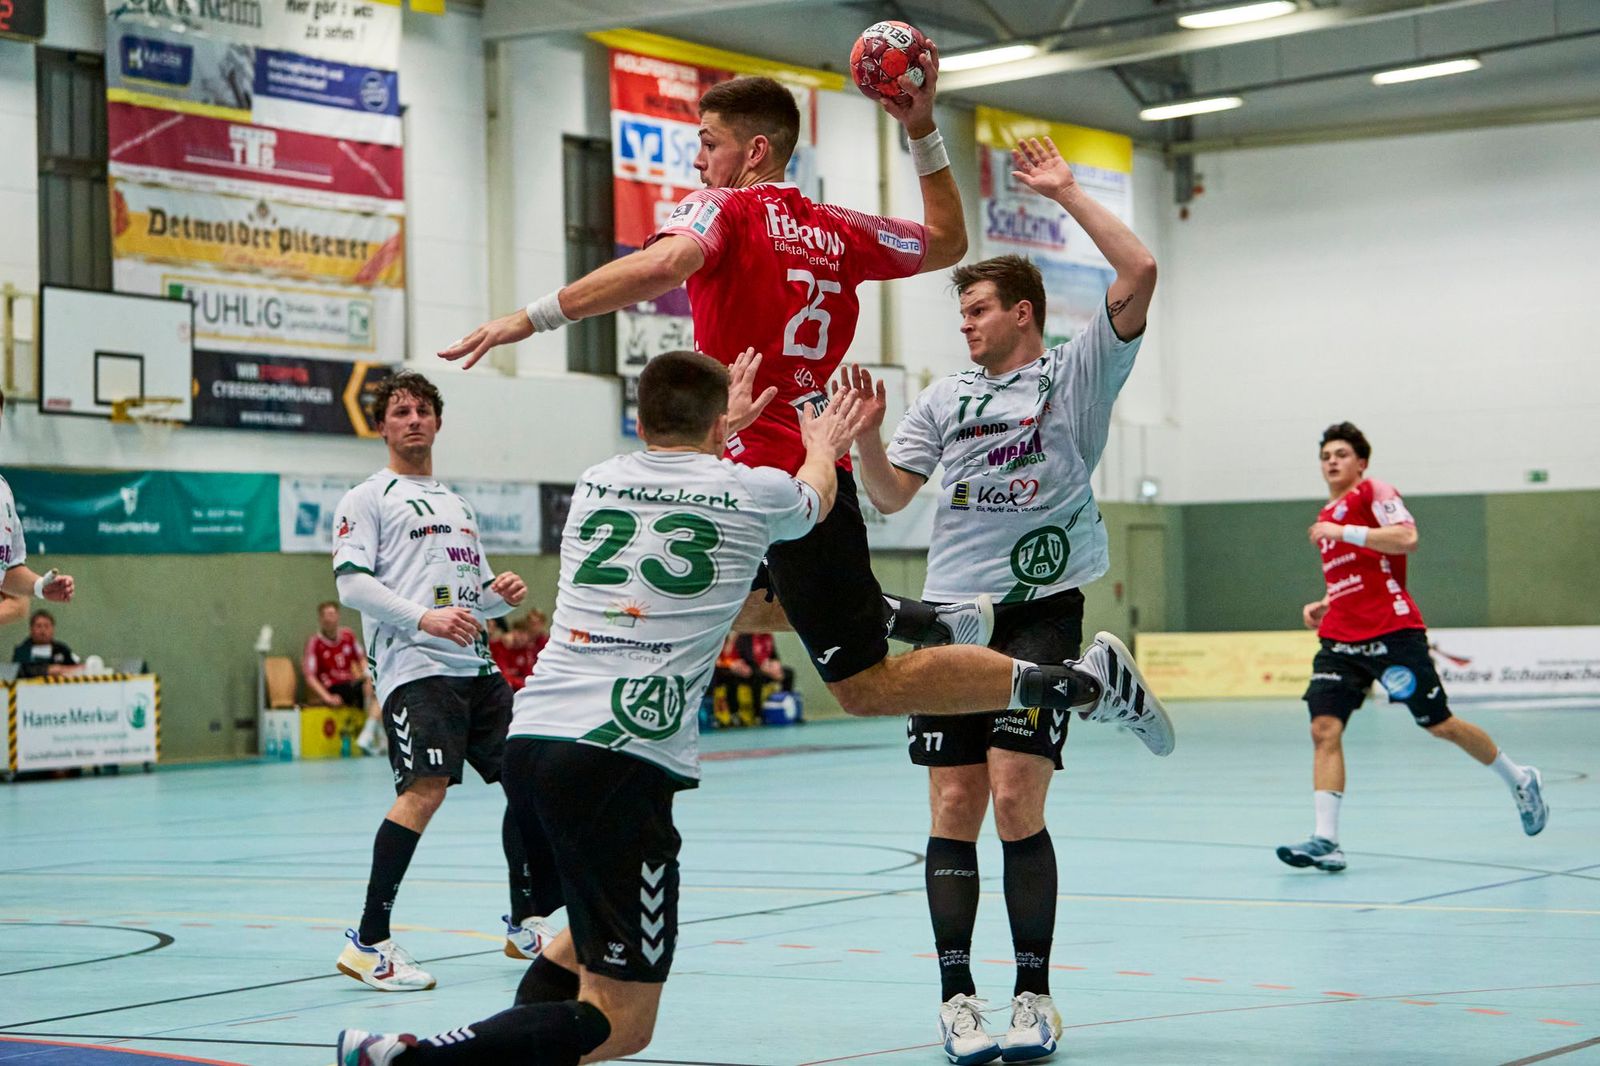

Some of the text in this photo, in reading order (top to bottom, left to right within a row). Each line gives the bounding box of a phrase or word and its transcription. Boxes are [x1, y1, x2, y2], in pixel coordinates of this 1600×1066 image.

[148, 207, 370, 260] Detmolder Pilsener
[571, 507, 724, 599] 23
[427, 748, 443, 765] 11
[923, 732, 943, 751] 77
